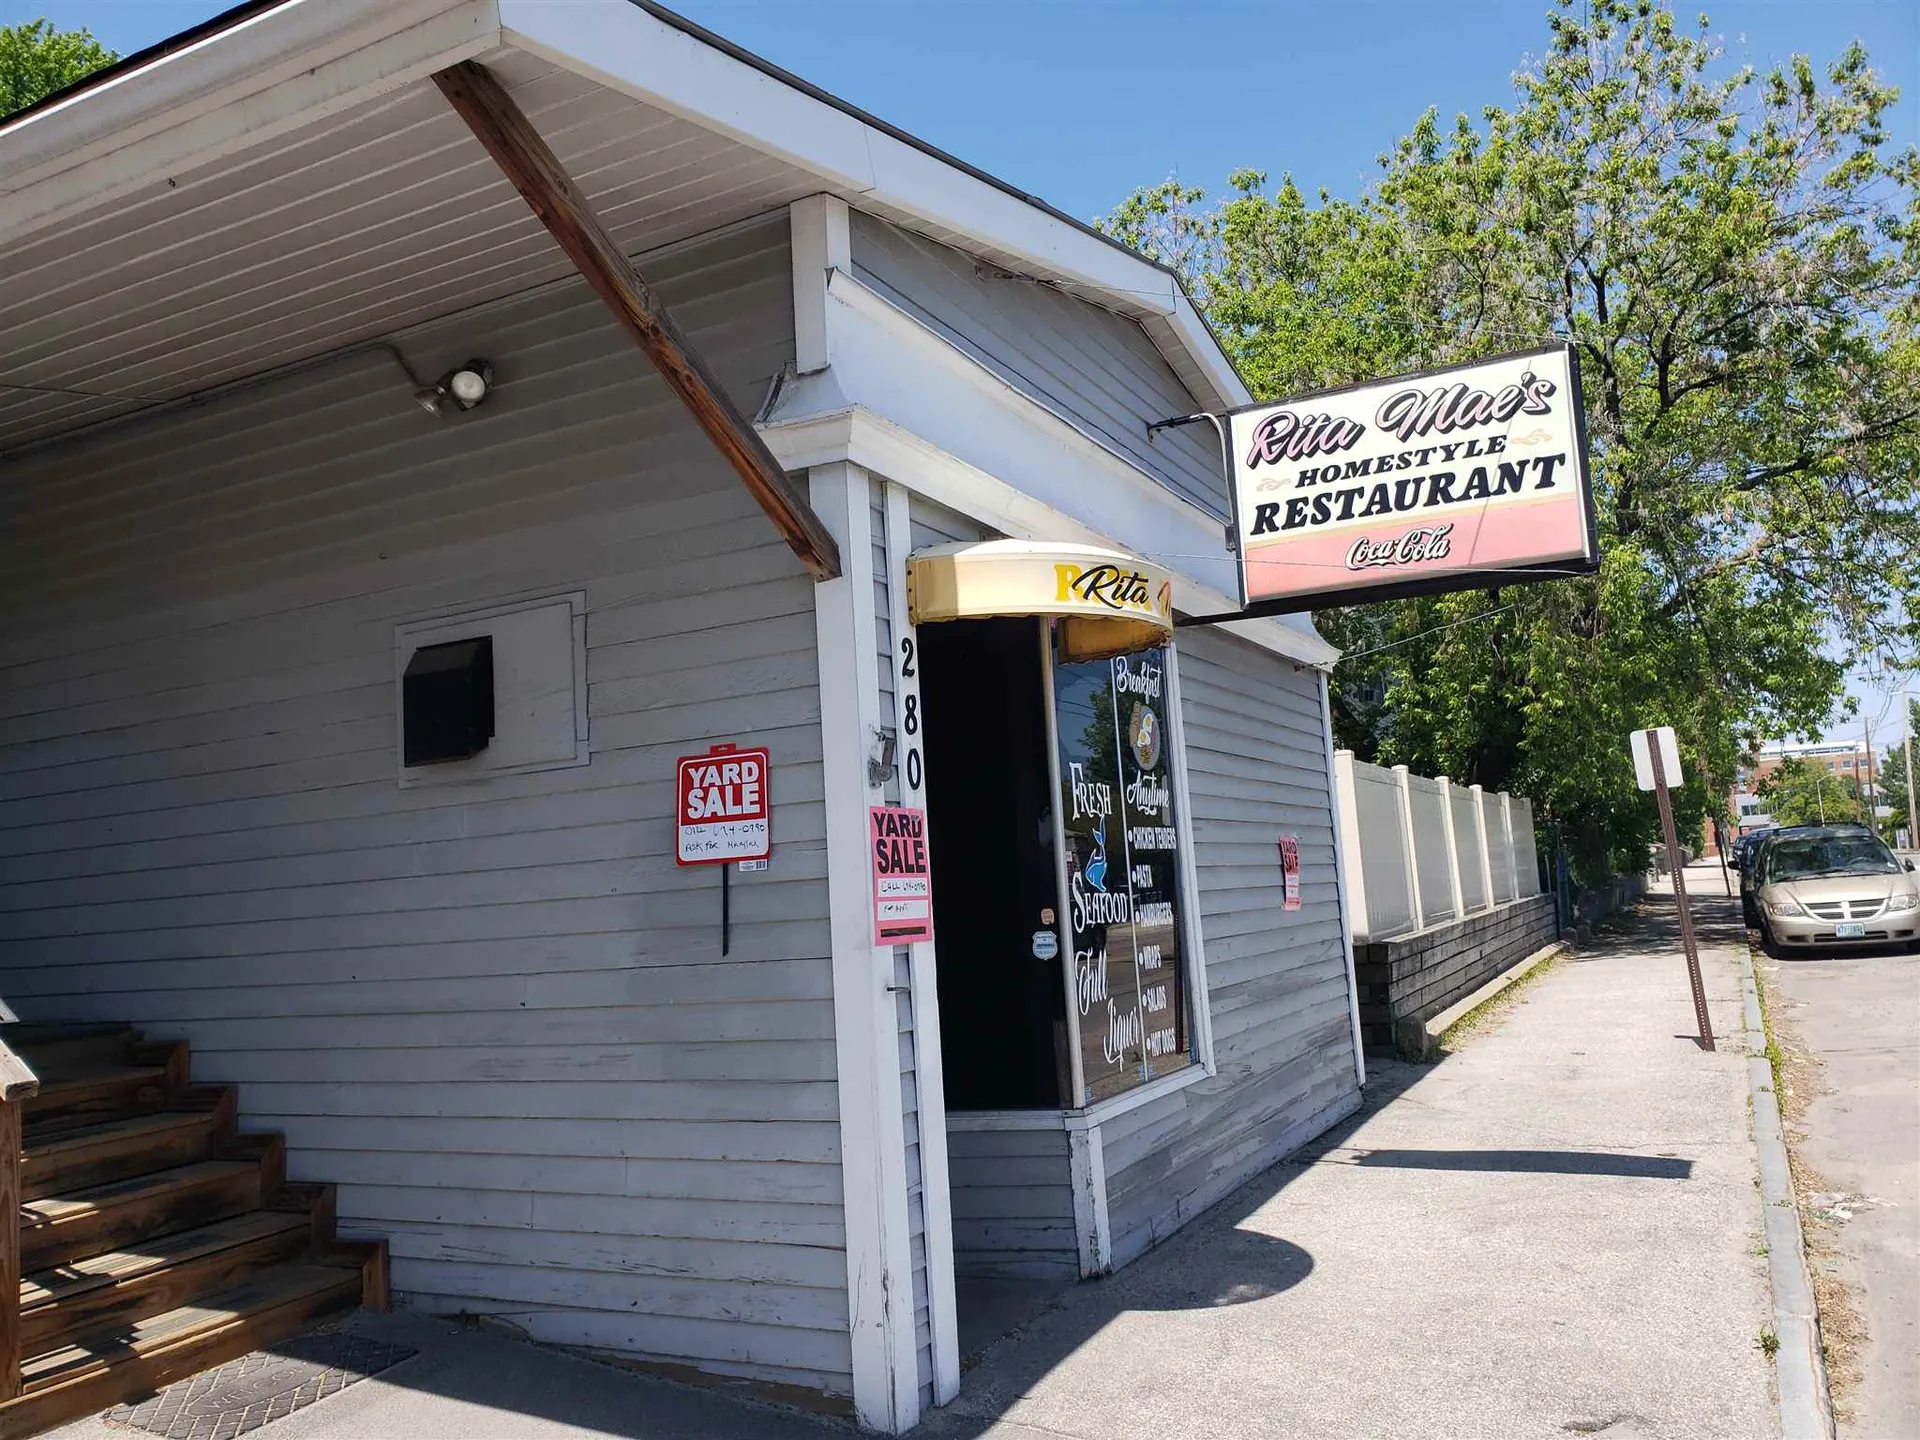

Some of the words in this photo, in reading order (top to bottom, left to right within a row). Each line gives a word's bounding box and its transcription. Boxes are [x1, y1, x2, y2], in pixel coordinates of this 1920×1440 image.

[1247, 411, 1365, 470] Rita
[1375, 371, 1557, 440] Mae's
[1295, 434, 1508, 489] HOMESTYLE
[1250, 452, 1566, 536] RESTAURANT
[1072, 564, 1149, 609] Rita
[1116, 656, 1162, 704] Breakfast
[688, 761, 759, 788] YARD
[687, 782, 760, 819] SALE
[1126, 770, 1169, 816] Anytime
[873, 812, 922, 838] YARD
[1133, 826, 1156, 850] CHICKEN
[1155, 826, 1177, 850] TENDERS
[876, 839, 926, 874] SALE
[1136, 864, 1153, 888] PASTA
[1142, 944, 1161, 970] WRAPS
[1074, 946, 1109, 1016] Full
[1147, 984, 1167, 1013] SALADS
[1150, 1030, 1162, 1058] HOT
[1161, 1026, 1176, 1054] DOGS
